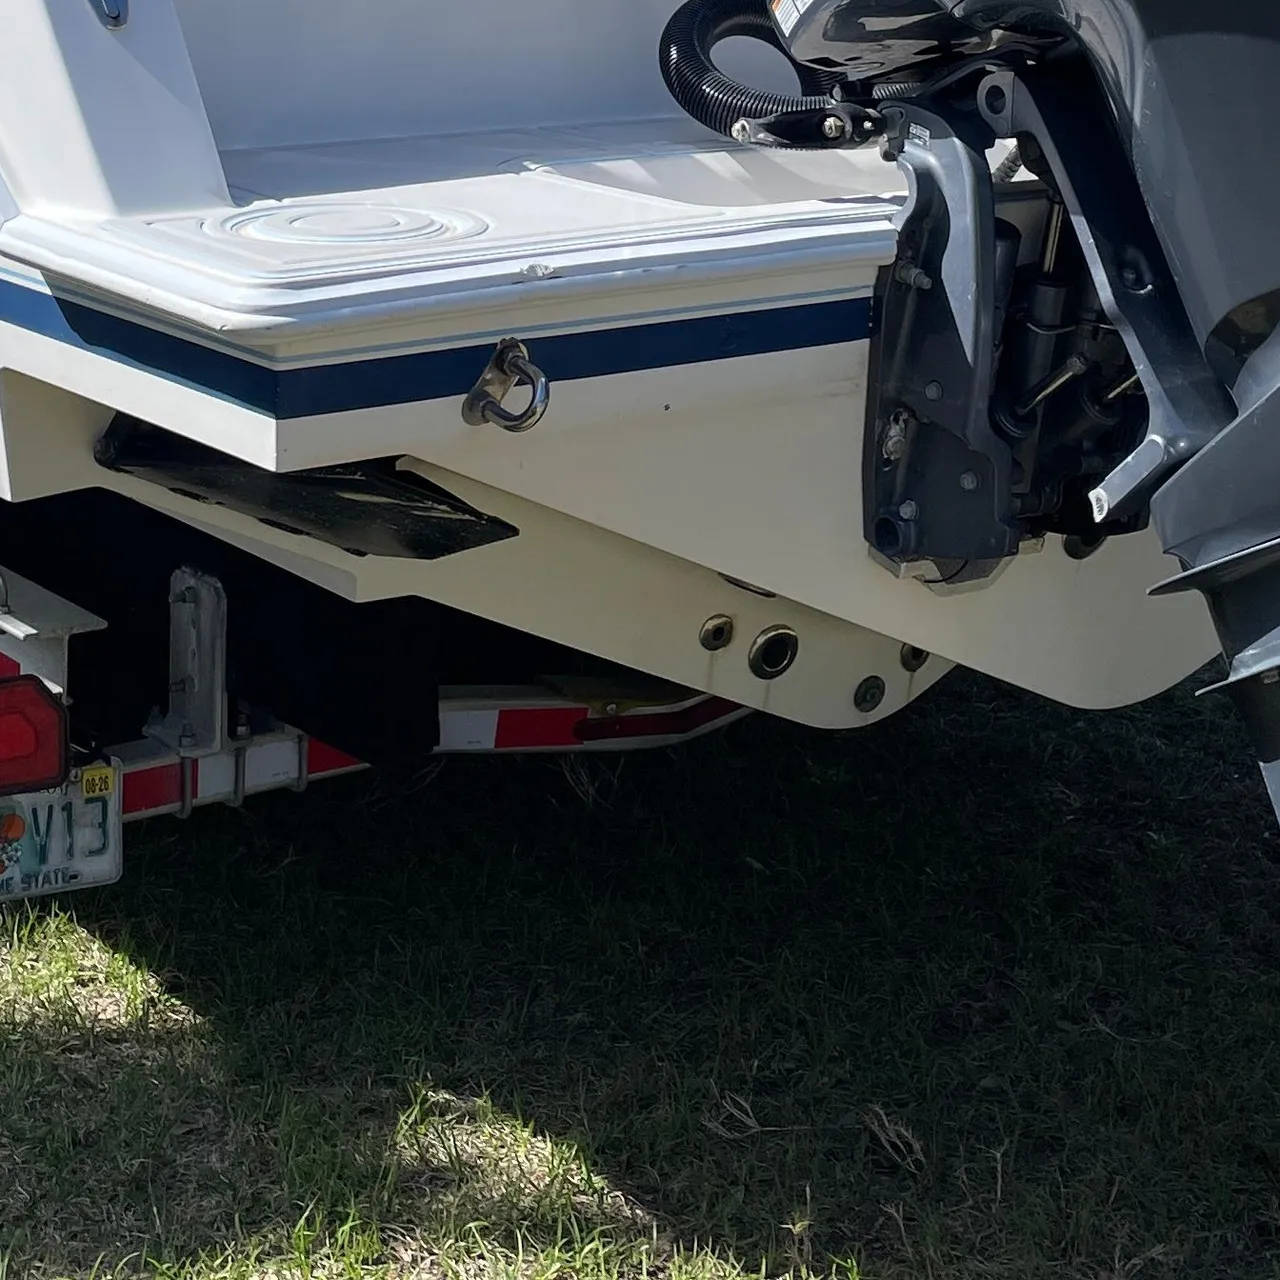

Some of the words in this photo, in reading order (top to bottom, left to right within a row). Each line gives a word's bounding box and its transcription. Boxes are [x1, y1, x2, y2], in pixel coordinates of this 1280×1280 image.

[85, 774, 110, 794] 08-26
[31, 795, 109, 866] V13
[21, 867, 71, 892] STATE
